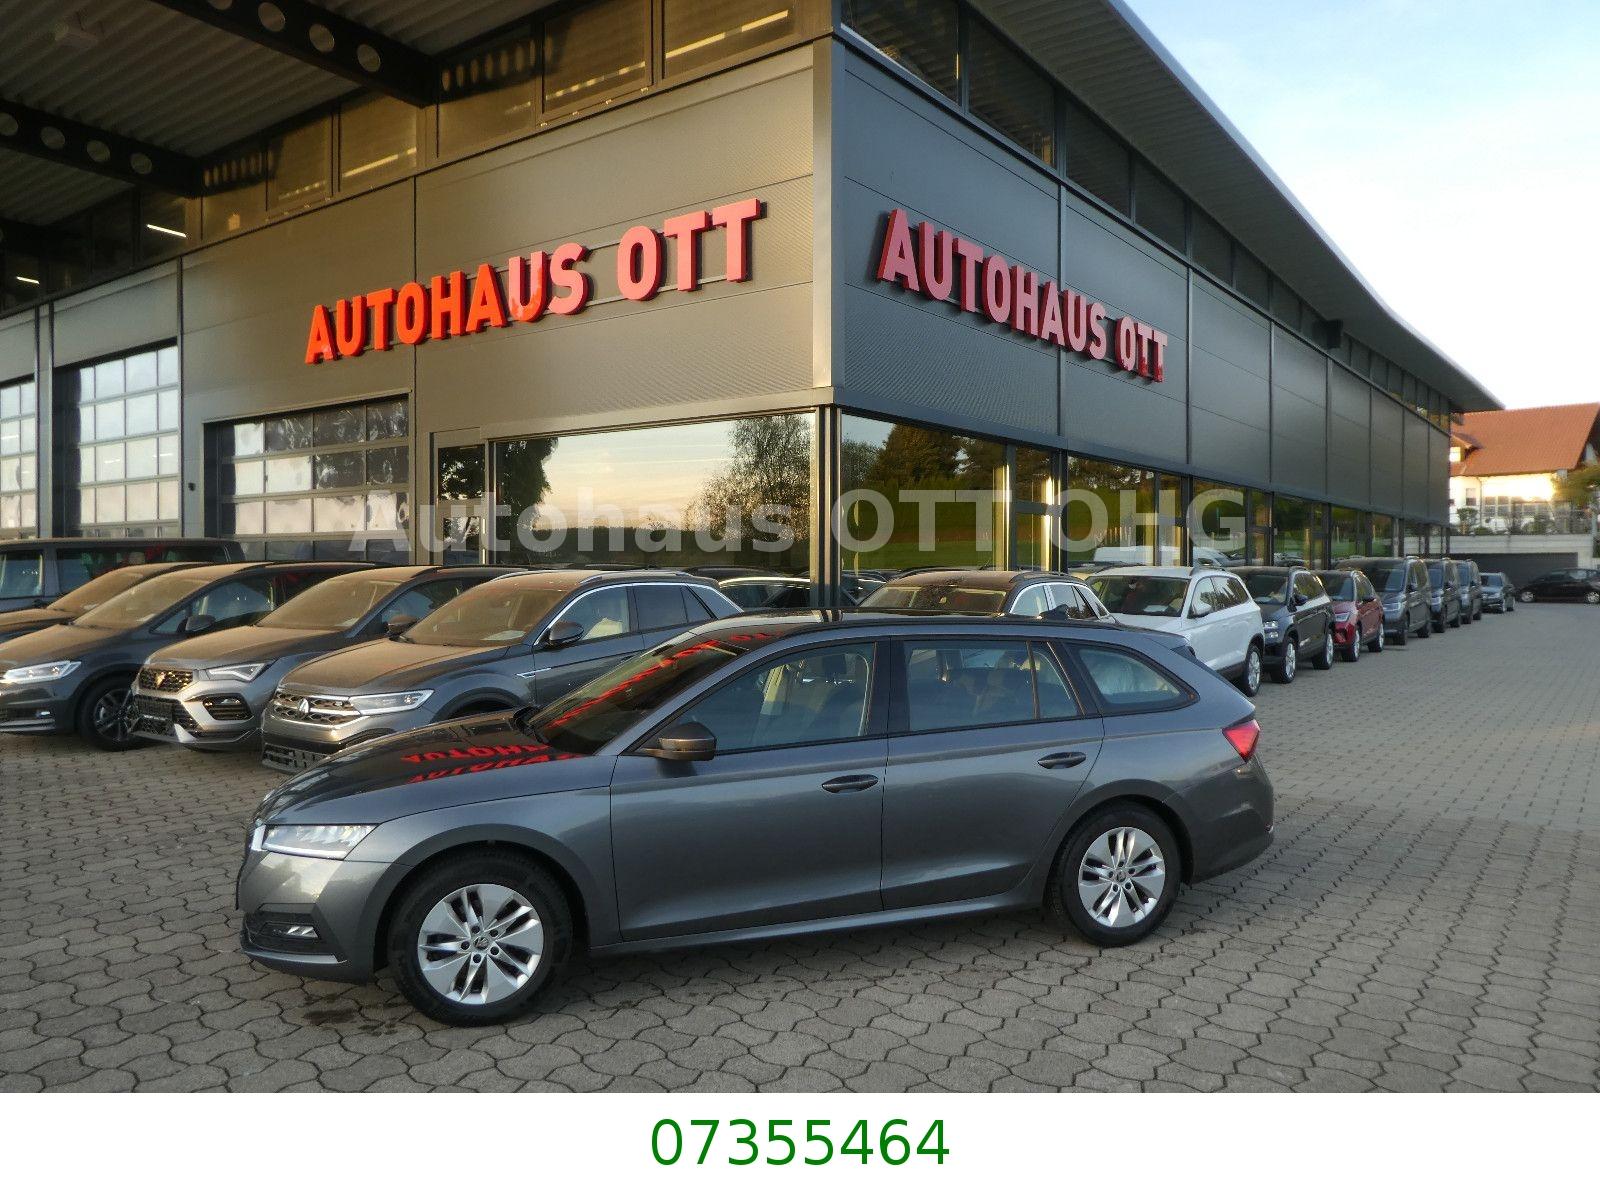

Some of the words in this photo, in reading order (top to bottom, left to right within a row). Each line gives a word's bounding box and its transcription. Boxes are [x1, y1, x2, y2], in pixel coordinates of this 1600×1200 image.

[305, 242, 590, 364] AUTOHAUS
[617, 198, 762, 301] OTT
[876, 208, 1107, 360] AUTOHAUS
[1115, 316, 1168, 383] OTT
